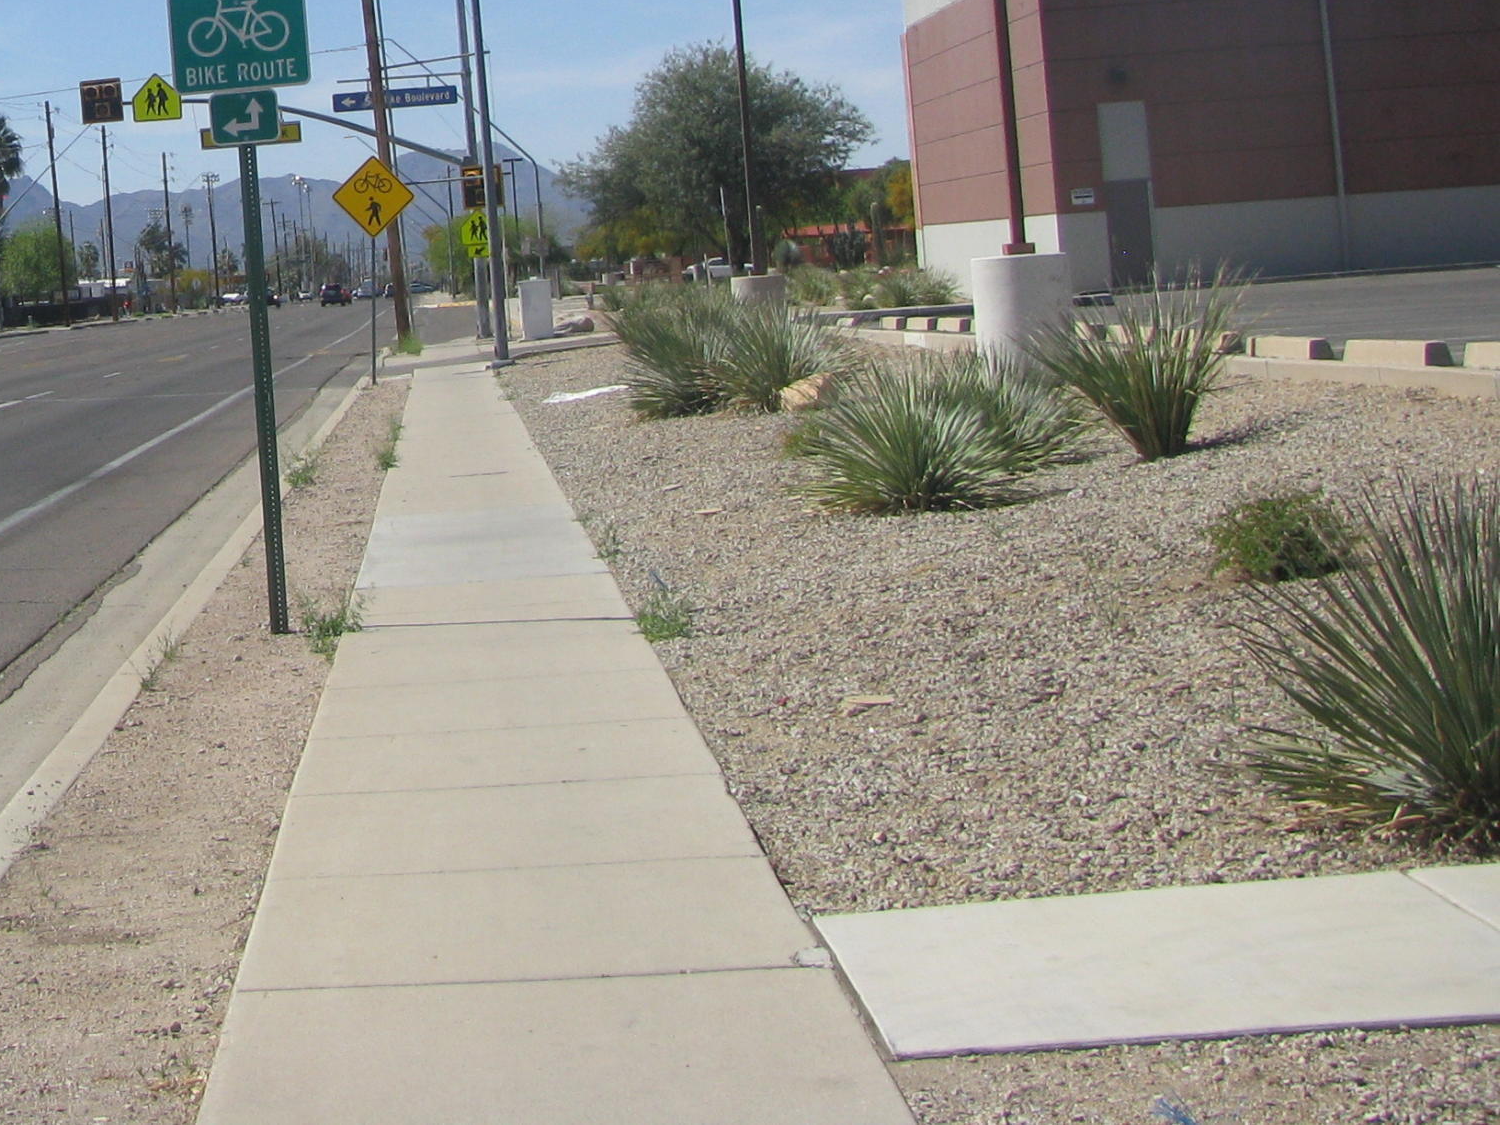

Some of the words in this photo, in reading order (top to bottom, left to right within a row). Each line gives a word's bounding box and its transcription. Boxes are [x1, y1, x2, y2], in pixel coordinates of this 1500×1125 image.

[185, 64, 229, 87] BIKE
[237, 58, 298, 82] ROUTE
[405, 91, 450, 104] Boulevard
